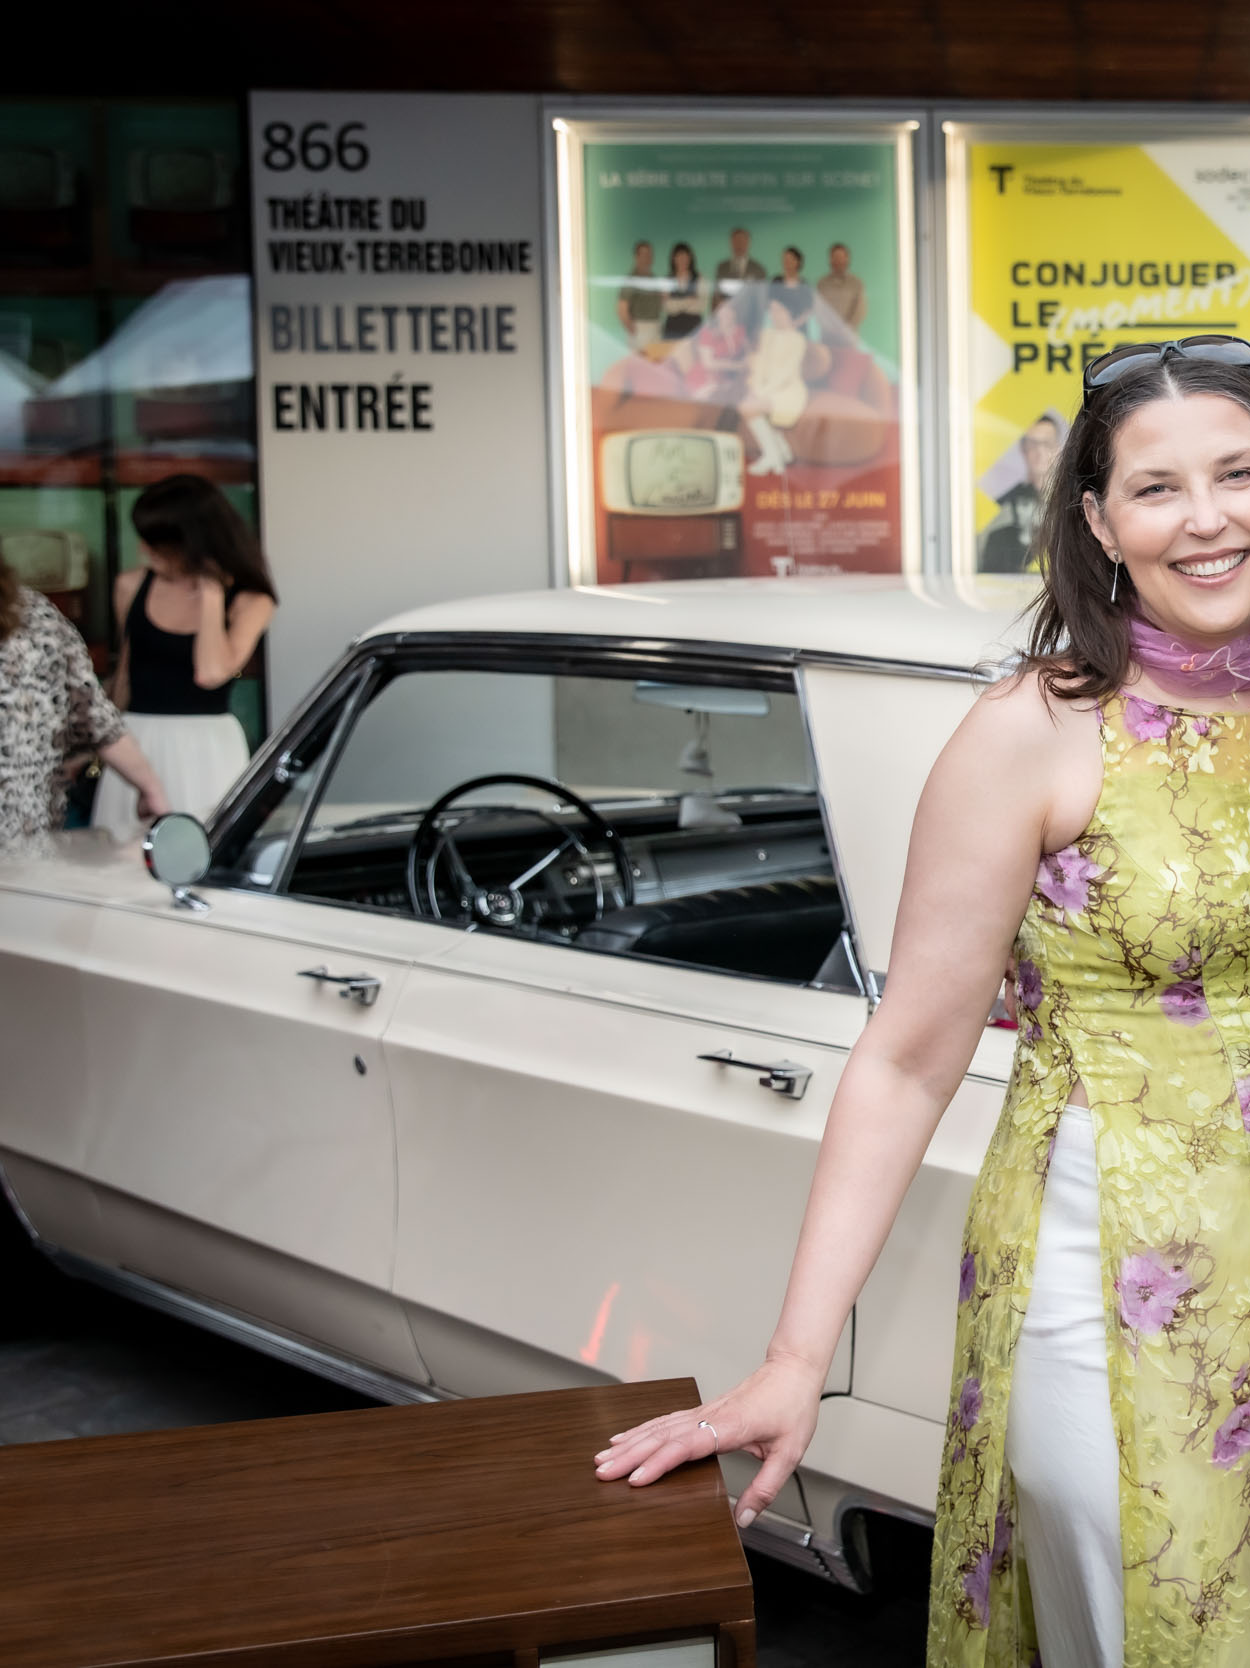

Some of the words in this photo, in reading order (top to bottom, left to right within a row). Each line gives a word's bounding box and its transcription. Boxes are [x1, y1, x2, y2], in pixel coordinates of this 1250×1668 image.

[263, 121, 370, 172] 866
[988, 164, 1014, 195] T
[268, 190, 382, 231] THÉÂTRE
[391, 198, 427, 231] DU
[268, 241, 533, 273] VIEUX-TERREBONNE
[1011, 262, 1237, 287] CONJUGUER
[271, 305, 517, 353] BILLETTERIE
[1012, 301, 1060, 328] LE
[273, 373, 434, 432] ENTRÉE
